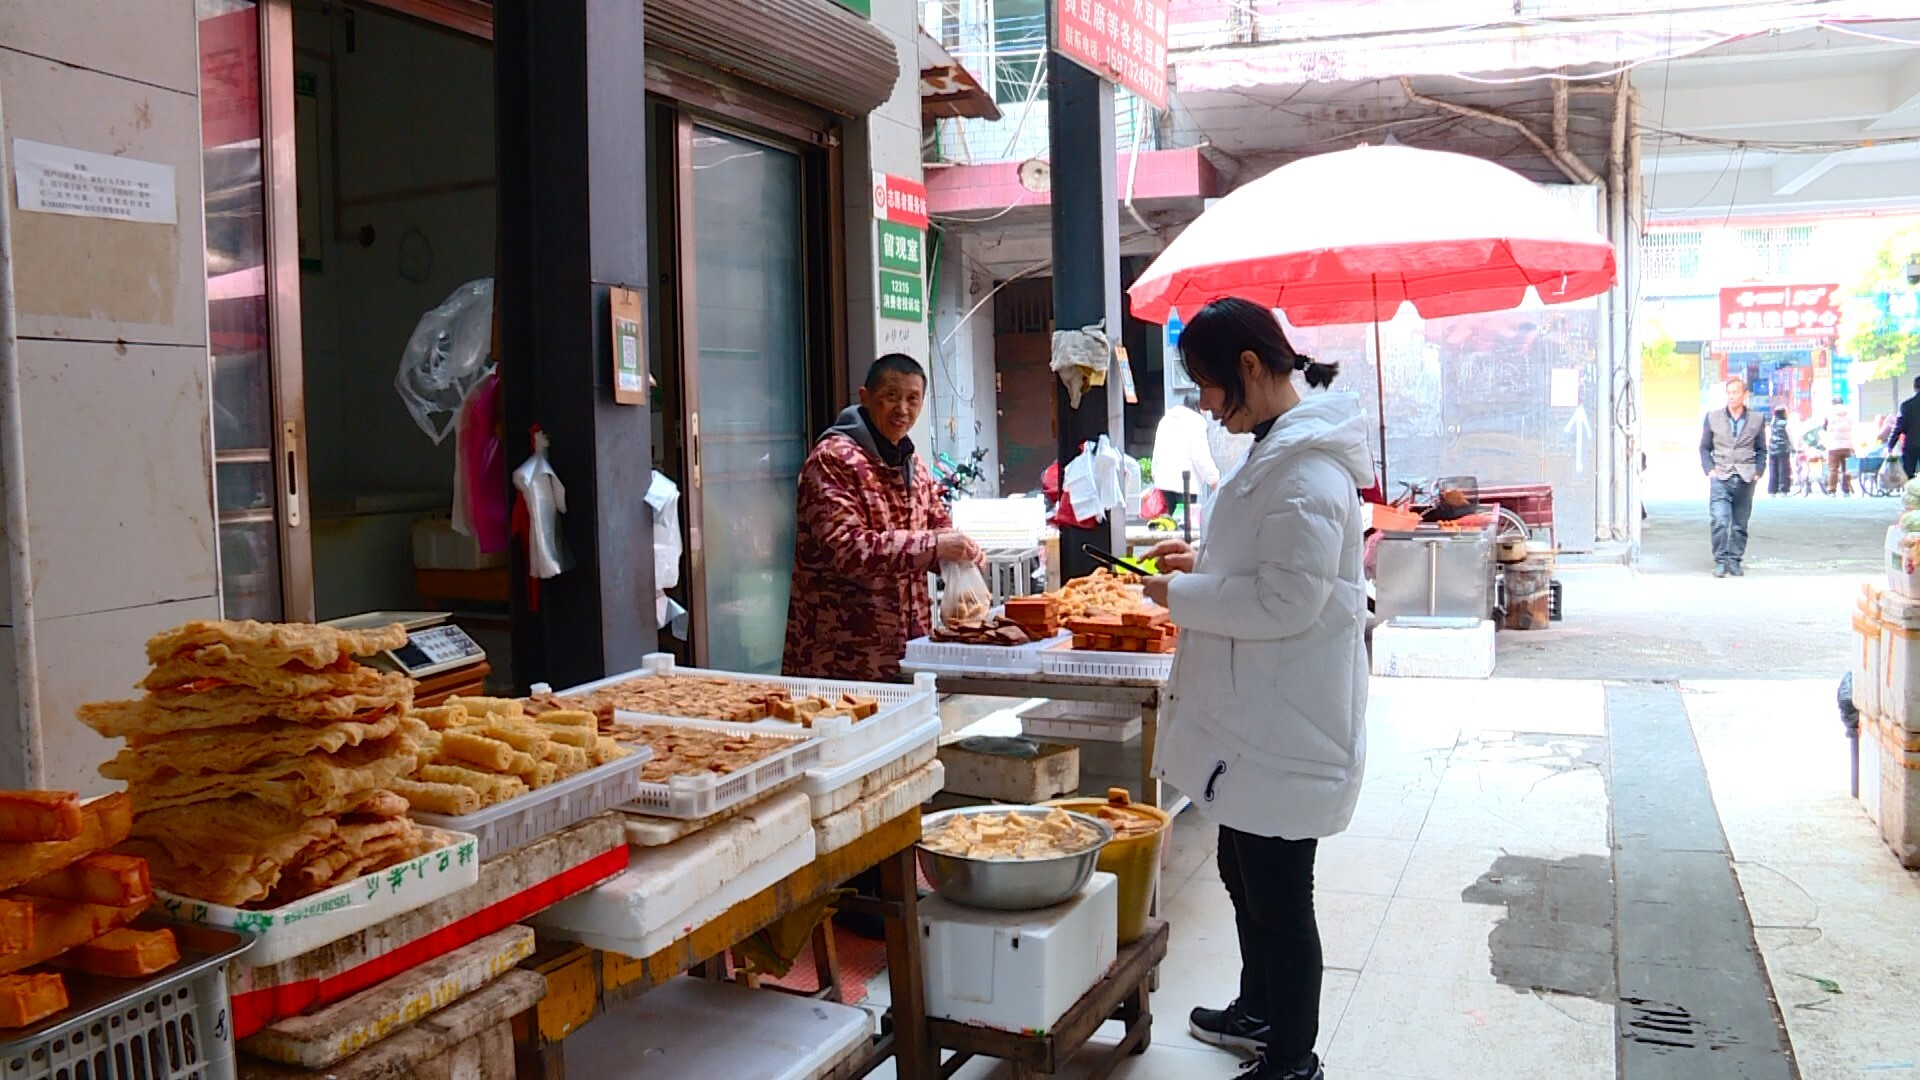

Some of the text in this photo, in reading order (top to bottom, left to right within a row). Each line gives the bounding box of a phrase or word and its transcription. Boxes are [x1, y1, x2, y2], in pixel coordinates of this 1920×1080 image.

[1105, 45, 1163, 98] 15973248727
[887, 188, 927, 217] 志愿者服务站
[883, 232, 919, 262] 留观室
[891, 279, 910, 294] 12315
[883, 294, 921, 313] 消费者投诉站
